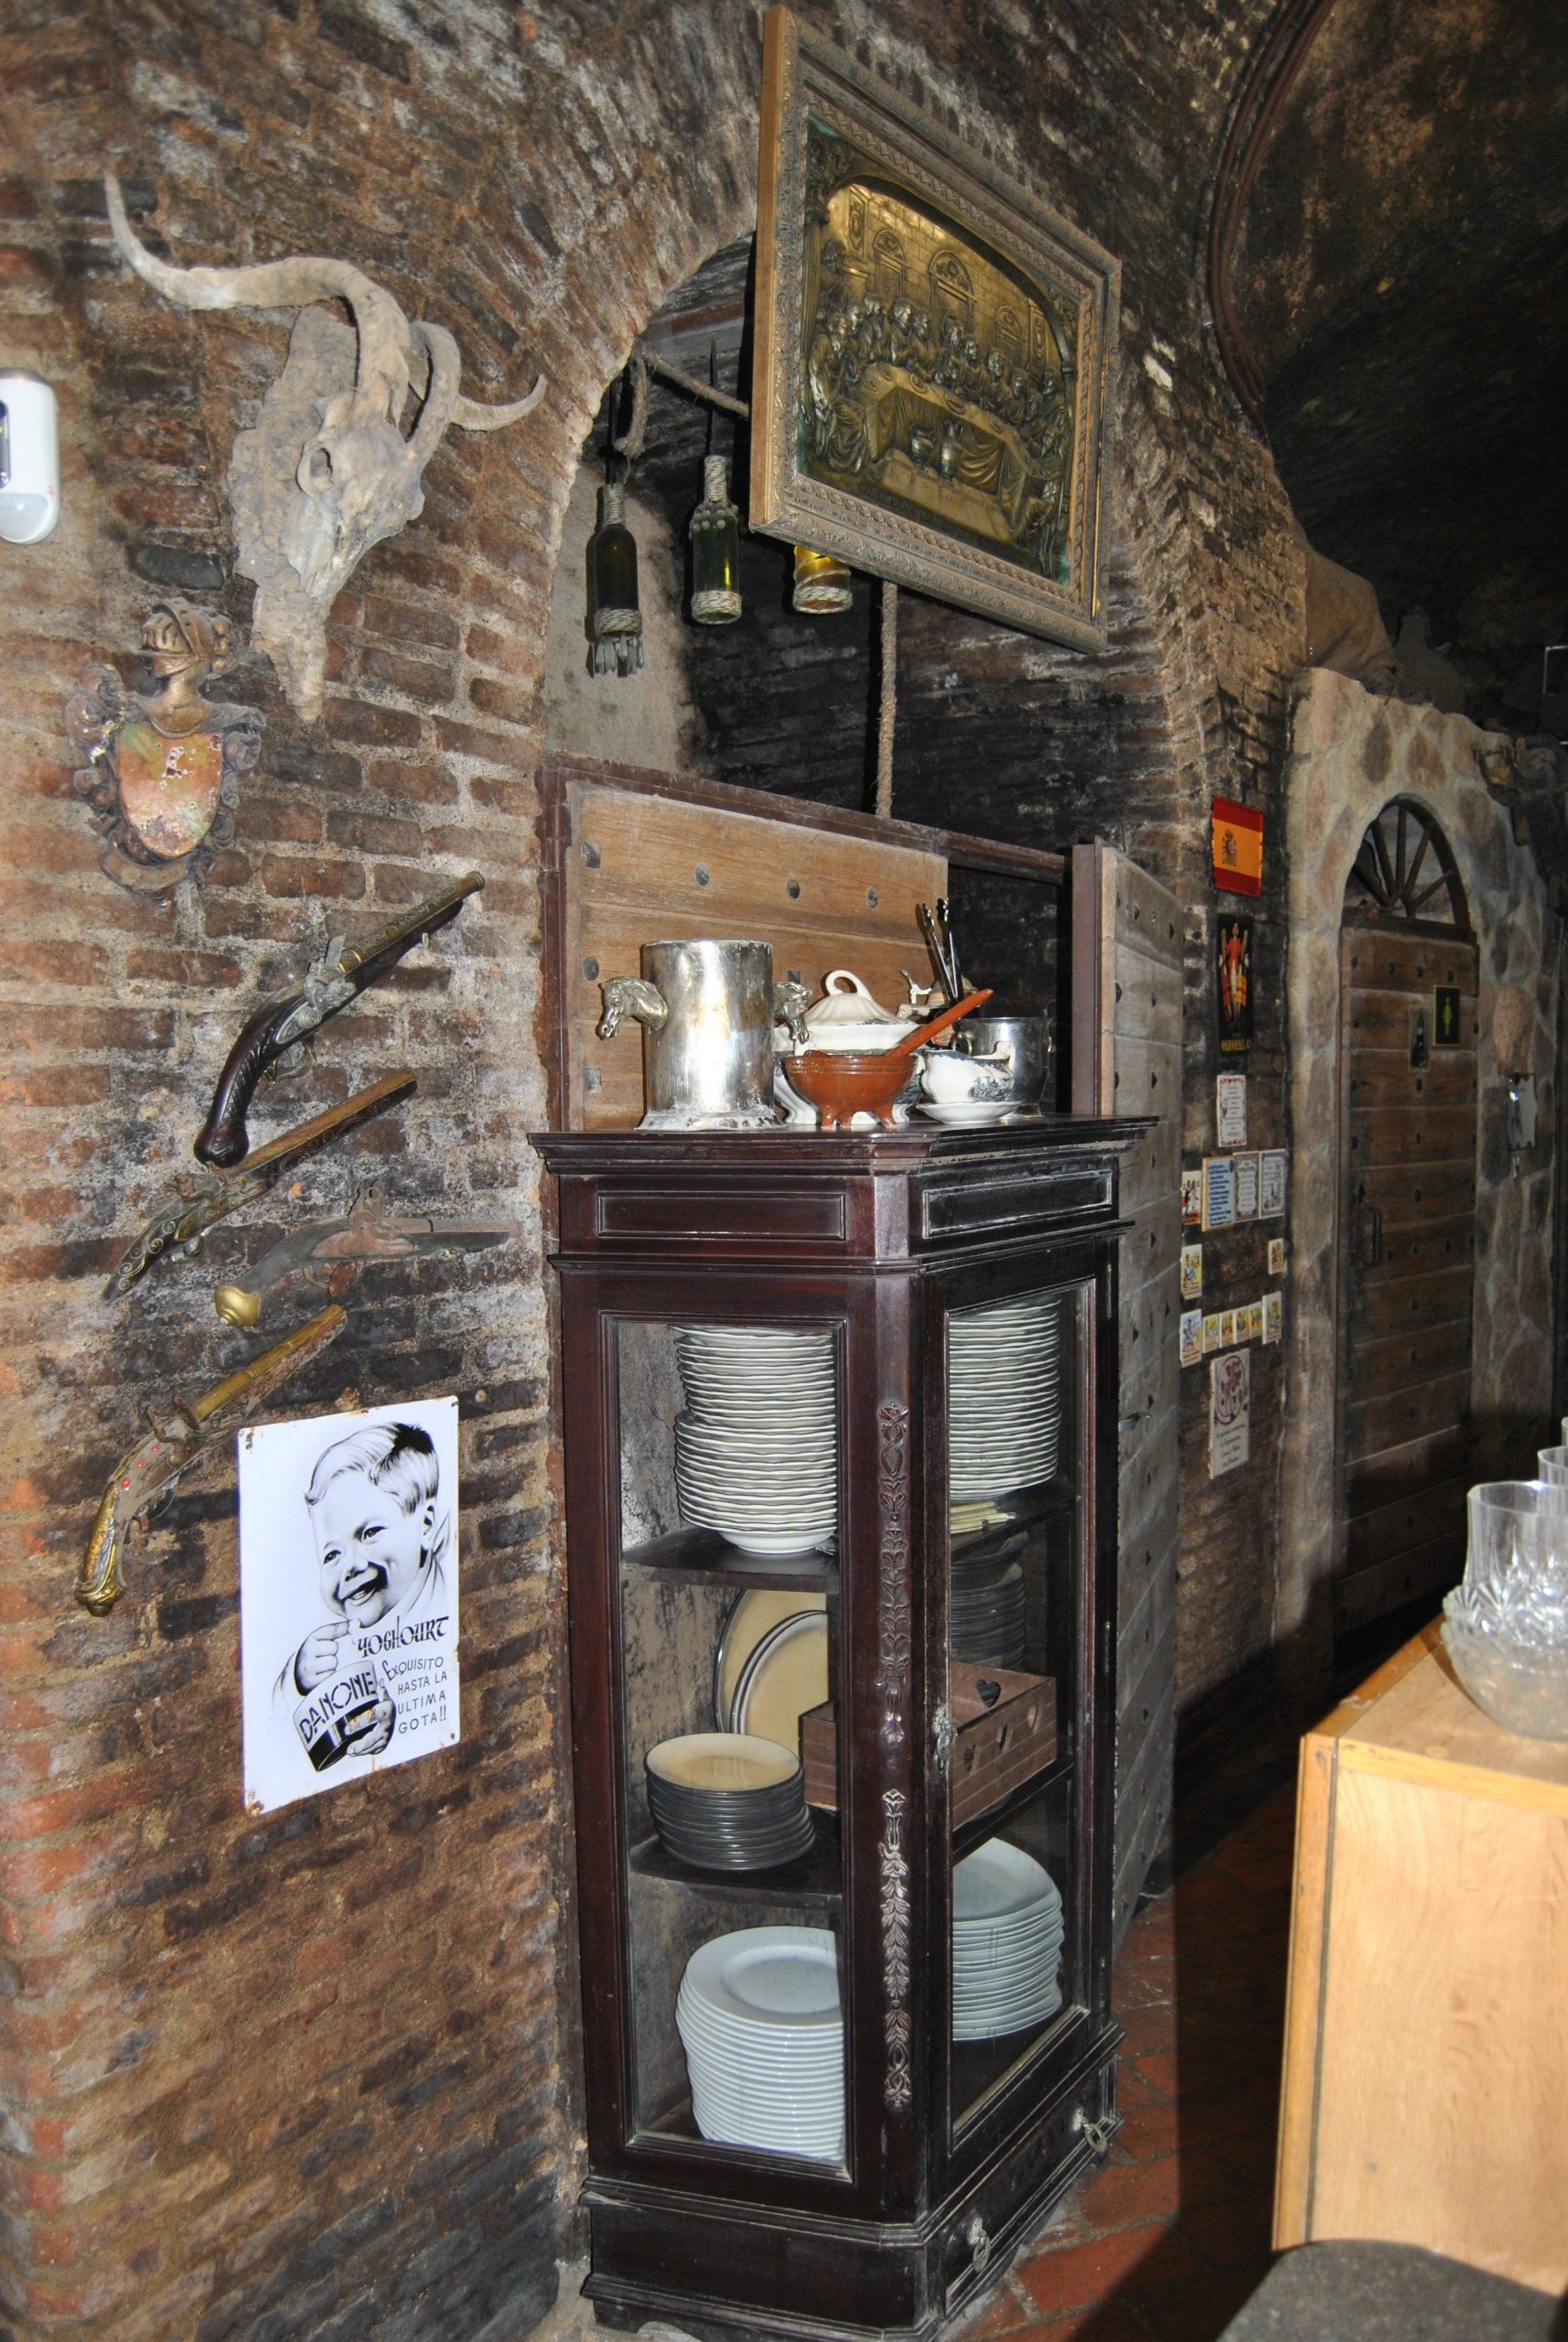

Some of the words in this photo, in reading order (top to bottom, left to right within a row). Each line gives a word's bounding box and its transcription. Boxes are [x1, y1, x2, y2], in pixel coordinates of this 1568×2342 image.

[358, 1616, 449, 1658] YOGHOURT
[398, 1676, 430, 1695] HASTA
[435, 1671, 447, 1684] LA
[299, 1672, 377, 1744] DANONE
[398, 1691, 446, 1714] ULTIMA
[398, 1705, 446, 1735] GOTA!!
